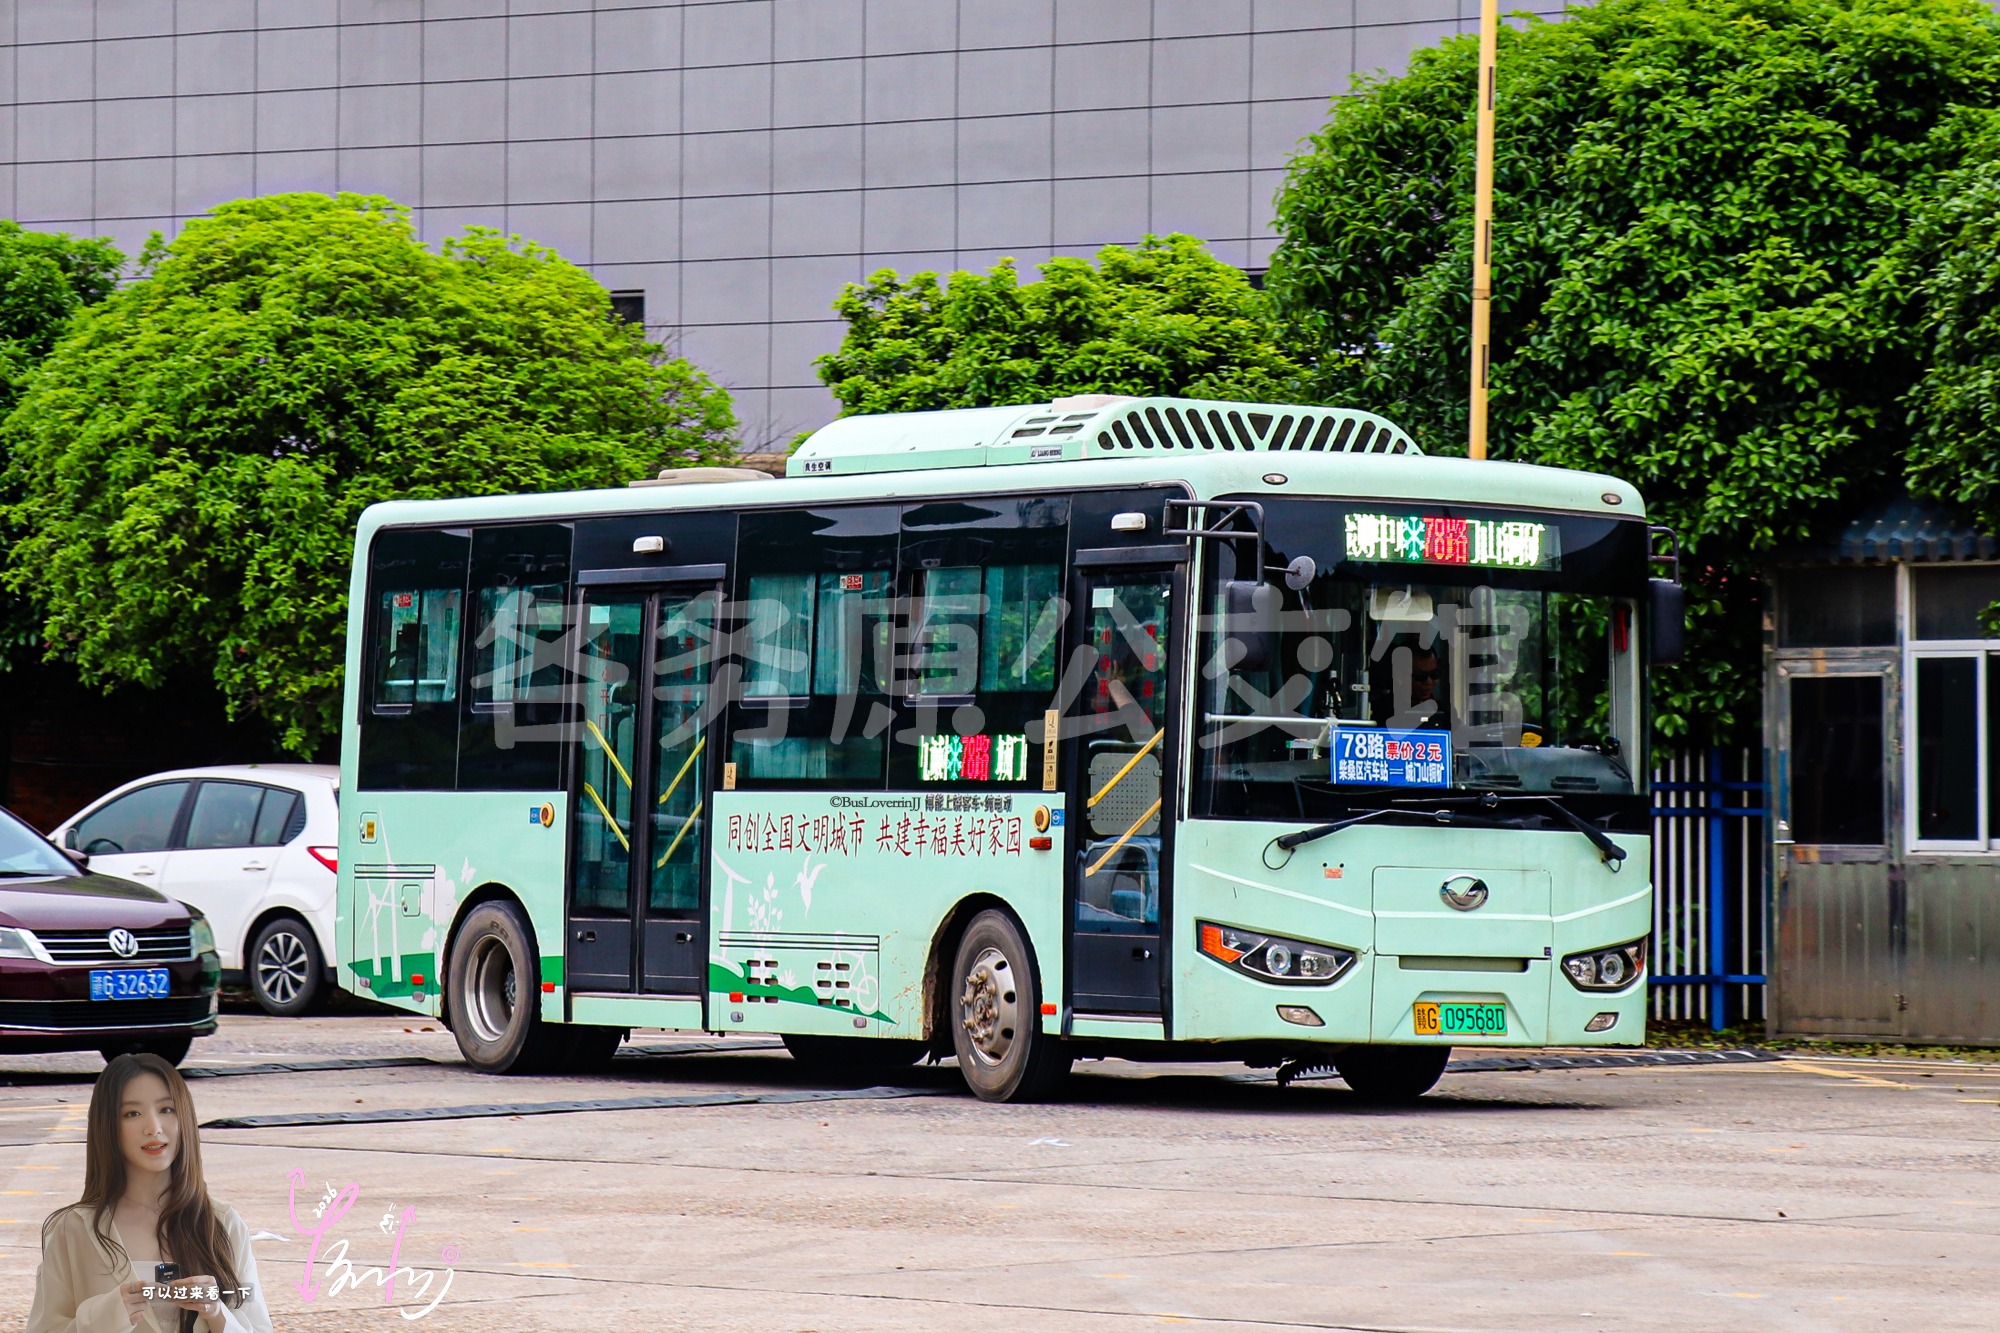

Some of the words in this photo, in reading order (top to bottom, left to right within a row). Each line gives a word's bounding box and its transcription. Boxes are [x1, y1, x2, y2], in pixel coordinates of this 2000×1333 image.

[1341, 733, 1384, 760] 78路
[1386, 741, 1443, 761] 票价2元
[1339, 759, 1389, 782] 柴桑区汽车站
[1405, 761, 1445, 783] 城门山铜矿
[728, 812, 866, 857] 同创全国文明城市
[875, 813, 1022, 858] 共建幸福美好家园
